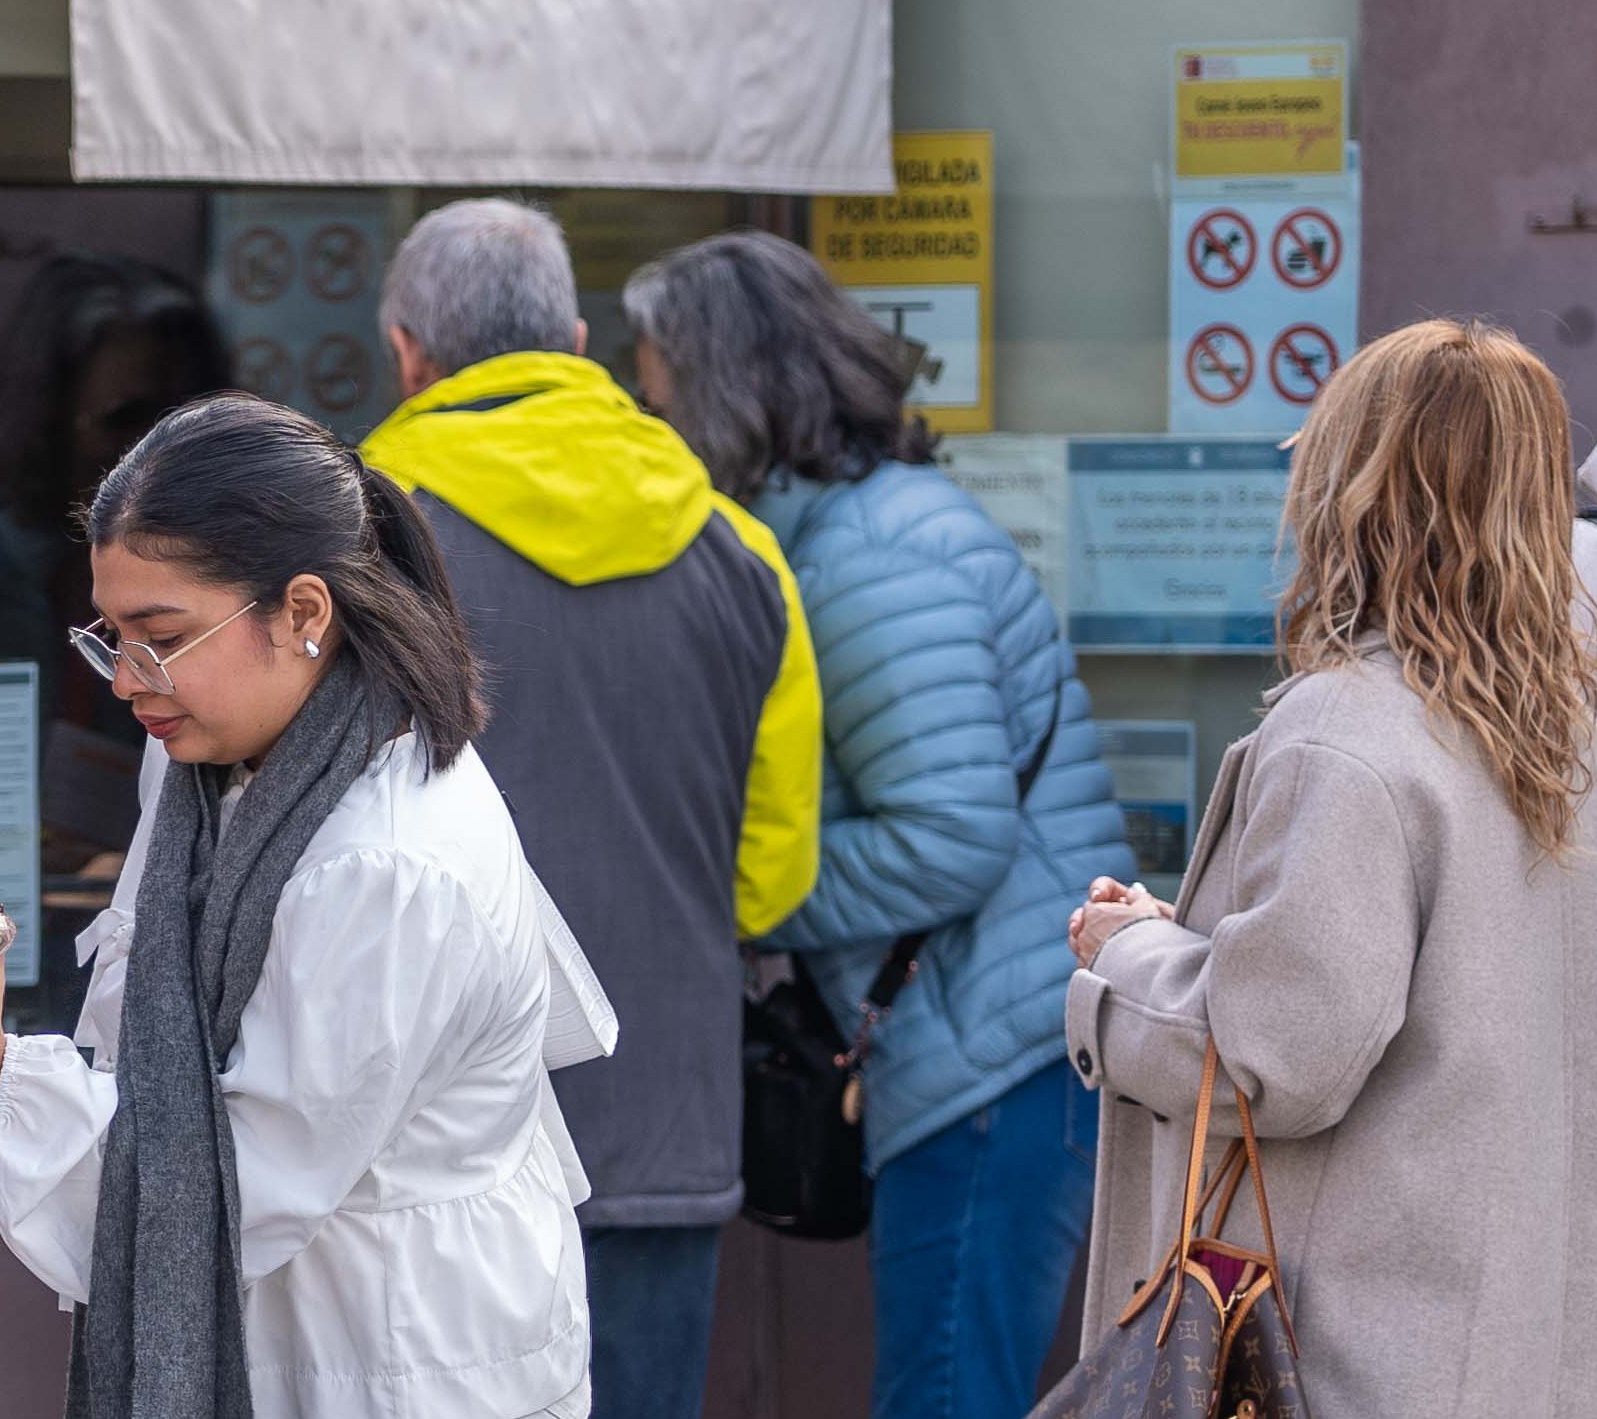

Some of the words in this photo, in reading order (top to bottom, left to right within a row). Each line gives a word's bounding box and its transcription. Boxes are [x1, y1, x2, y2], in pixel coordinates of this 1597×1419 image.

[834, 196, 878, 223] POR
[826, 233, 854, 262] DE
[862, 231, 982, 260] SEGURIDAD
